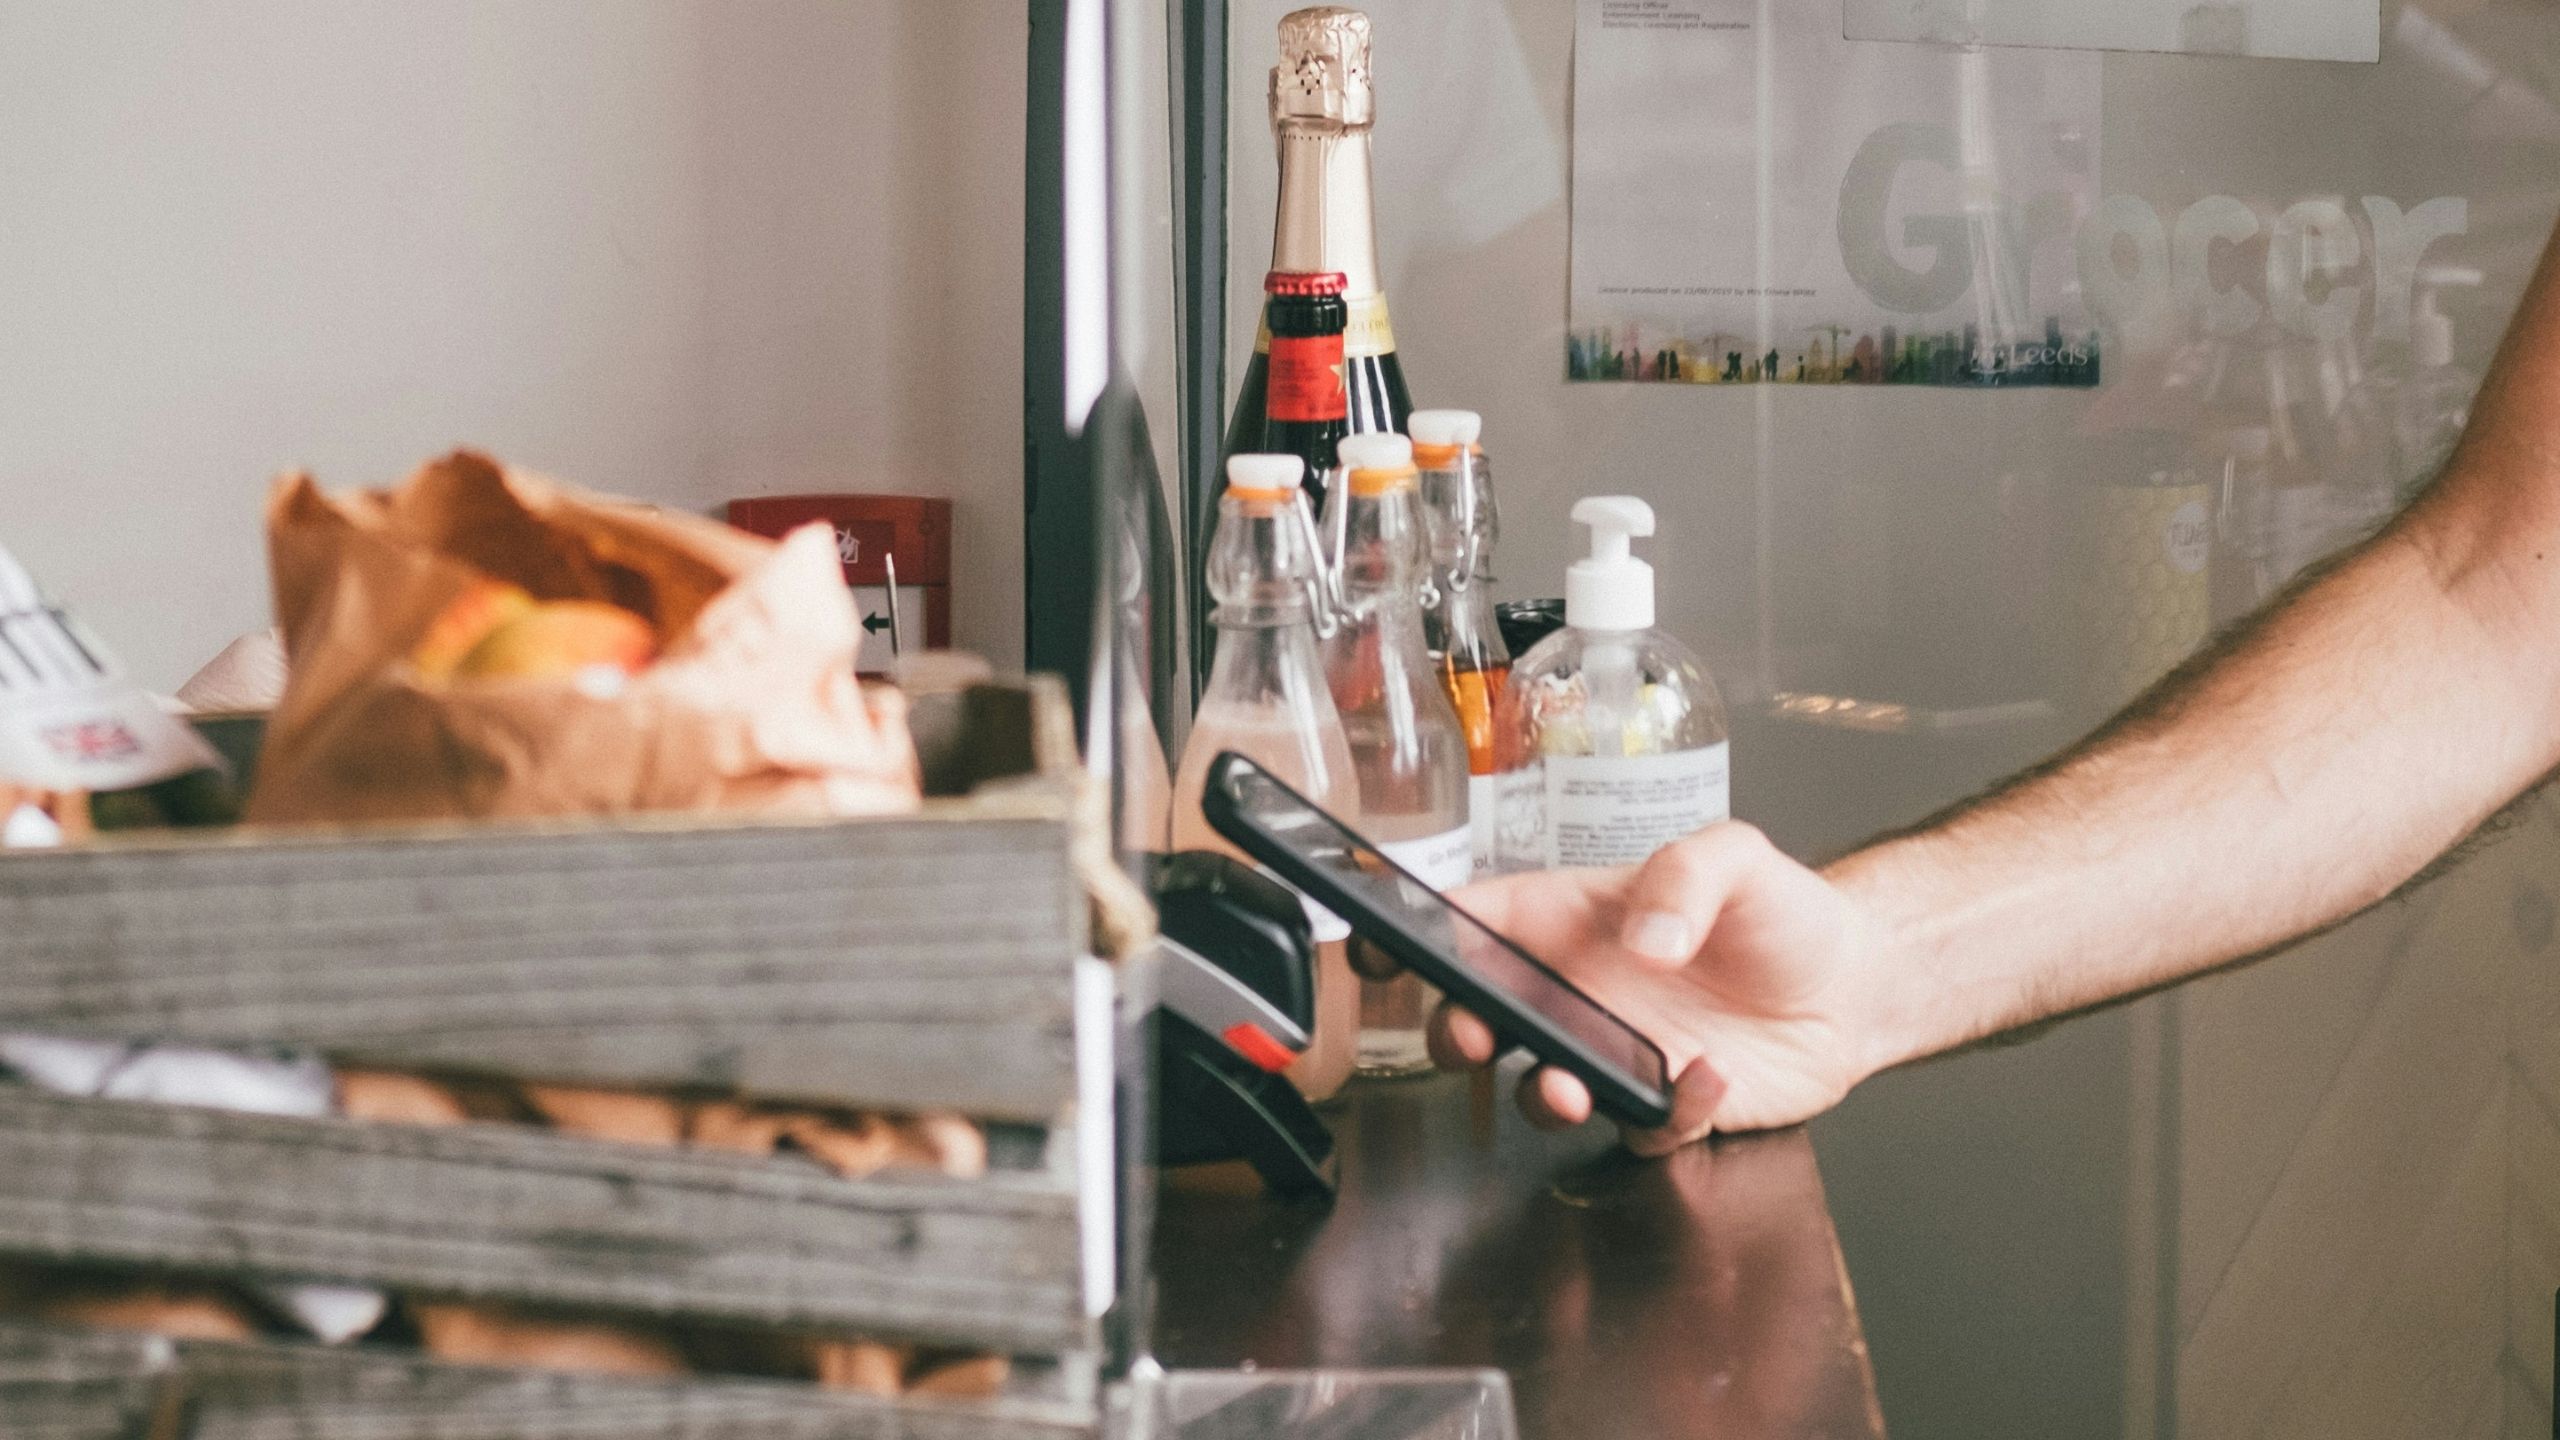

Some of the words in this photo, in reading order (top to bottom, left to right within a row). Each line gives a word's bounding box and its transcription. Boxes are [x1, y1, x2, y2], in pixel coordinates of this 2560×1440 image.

[1683, 21, 1699, 29] and
[1701, 21, 1751, 31] Registration
[1836, 122, 2467, 338] Grocer
[2010, 344, 2088, 367] Leeds
